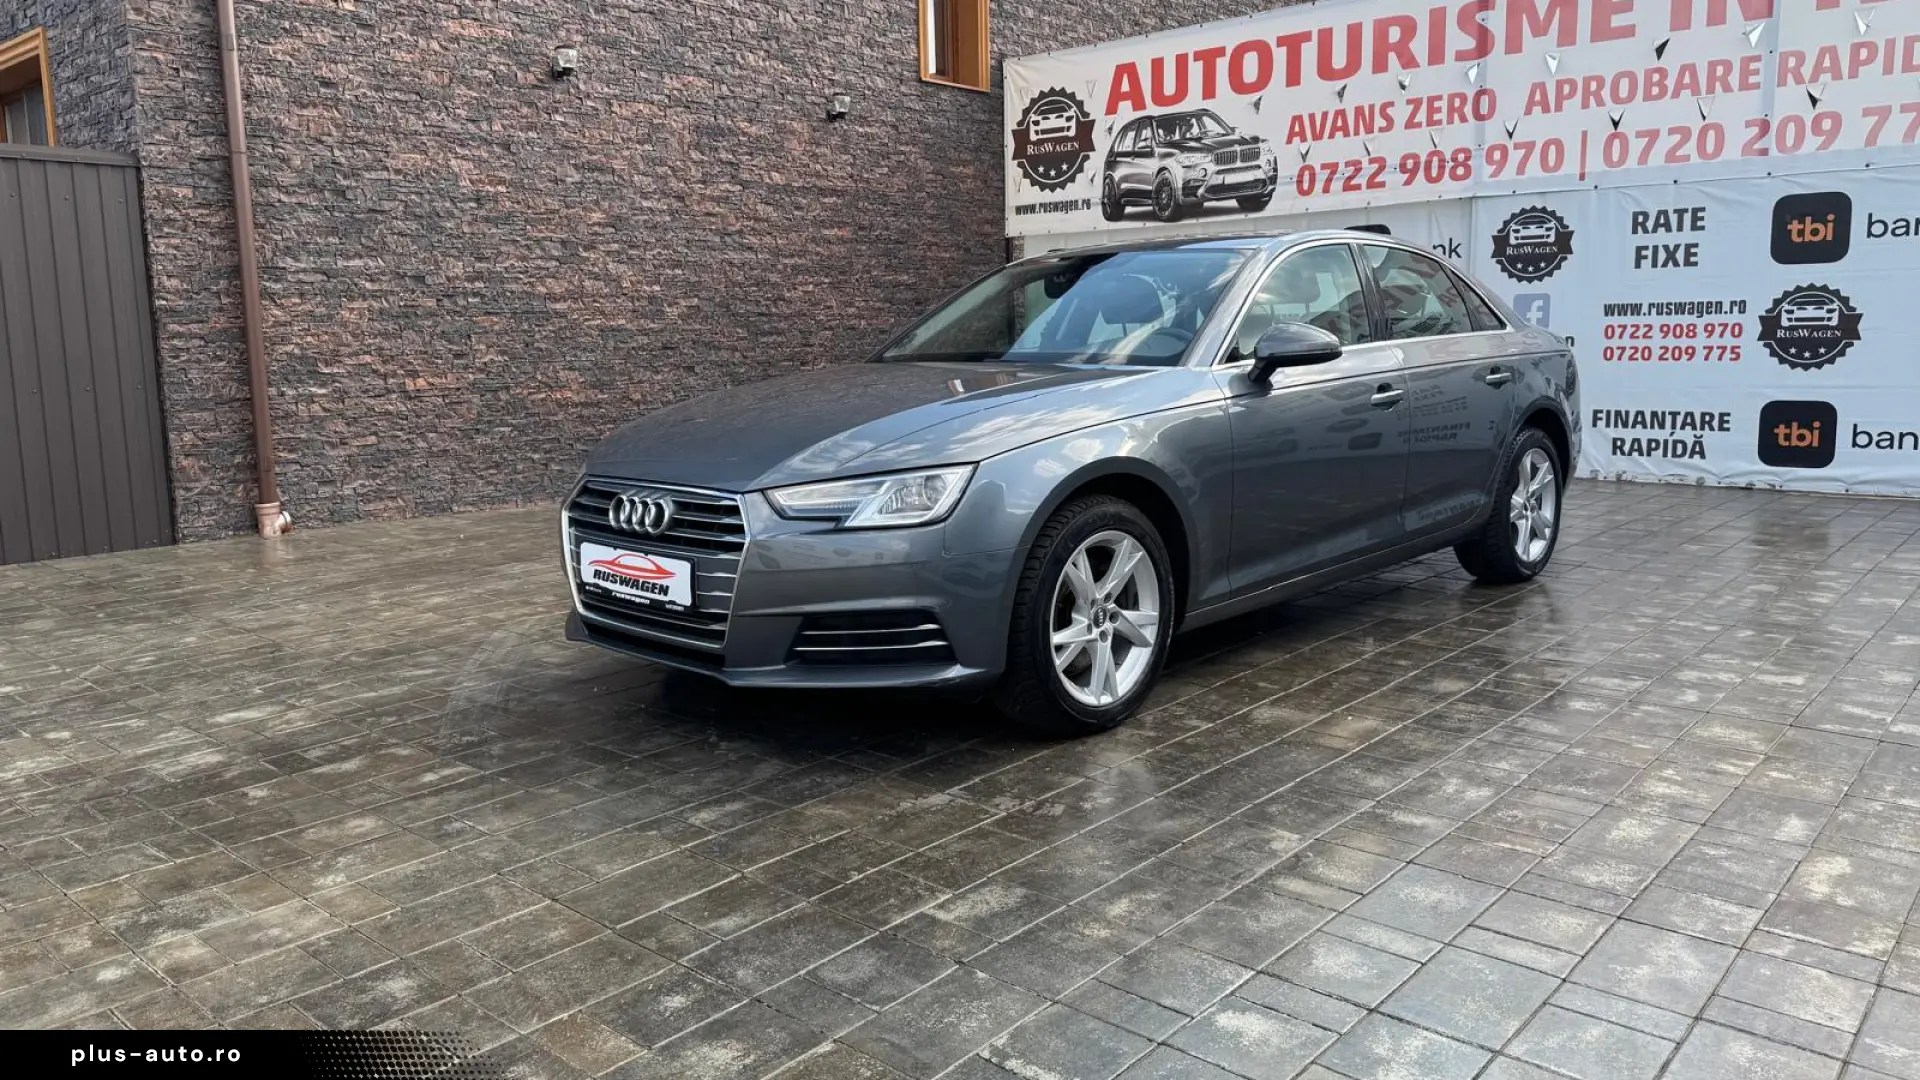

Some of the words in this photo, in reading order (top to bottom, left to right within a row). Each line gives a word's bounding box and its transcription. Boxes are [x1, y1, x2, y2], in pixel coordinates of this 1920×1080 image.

[1105, 0, 1636, 116] AUTOTURISME
[1285, 101, 1395, 145] AVANS
[1404, 87, 1497, 130] ZERO
[1524, 54, 1763, 116] APROBARE
[1026, 142, 1080, 156] RUSWAGEN
[1296, 156, 1387, 197] 0722
[1399, 147, 1473, 186] 908
[1485, 137, 1565, 178] 970
[1602, 122, 1725, 168] 0720
[1741, 111, 1842, 157] 209
[1014, 199, 1092, 216] www.ruswagen.ro
[1631, 206, 1706, 234] RATE
[1787, 213, 1836, 242] tbi
[1506, 245, 1558, 256] RUSWAGEN
[1634, 243, 1699, 269] FIXE
[1603, 299, 1747, 318] www.ruswagen.ro
[1603, 323, 1654, 340] 0722
[1659, 323, 1698, 339] 908
[1703, 322, 1744, 339] 970
[1776, 328, 1842, 338] RUSWAGEN
[1602, 346, 1653, 362] 0720
[1658, 346, 1697, 362] 209
[1702, 345, 1742, 362] 775
[1773, 421, 1822, 448] tbi
[592, 568, 670, 597] RUSWAGEN
